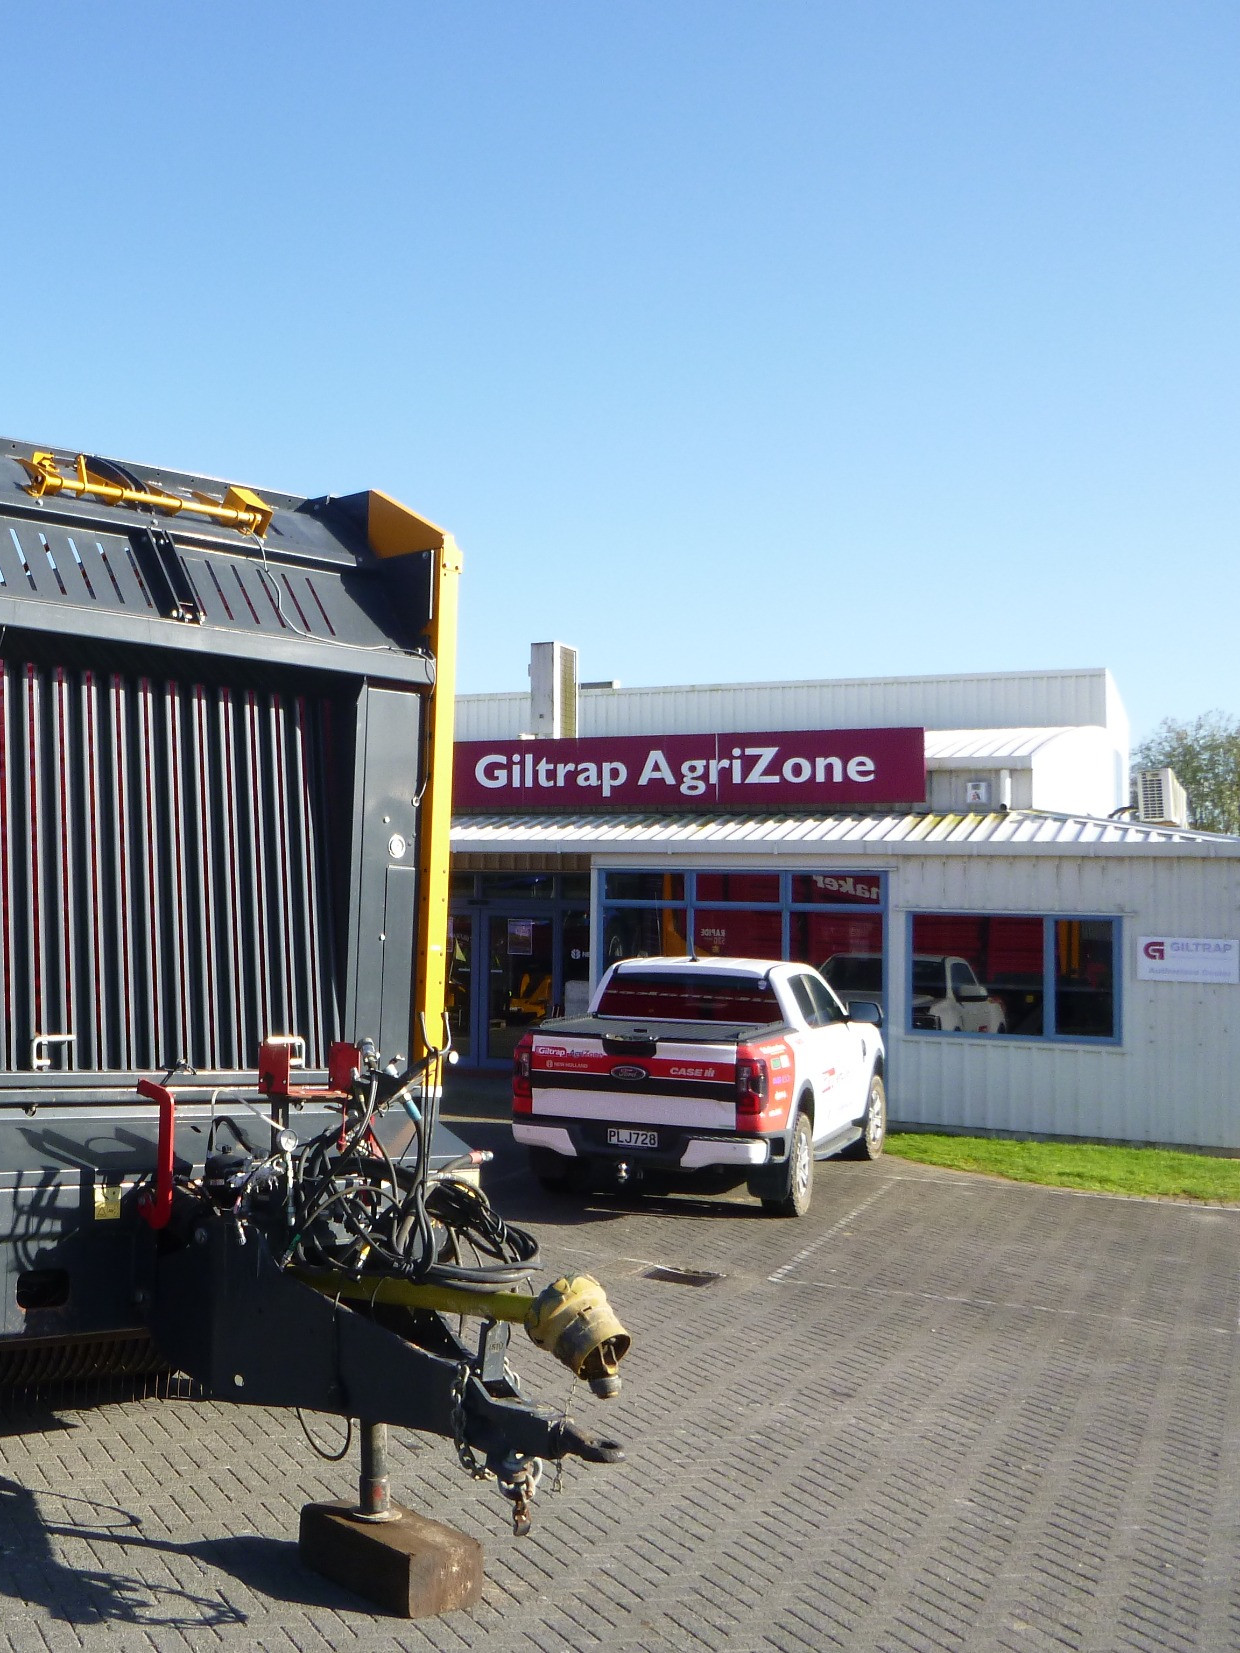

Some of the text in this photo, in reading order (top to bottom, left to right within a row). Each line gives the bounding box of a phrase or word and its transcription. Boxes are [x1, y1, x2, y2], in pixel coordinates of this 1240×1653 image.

[474, 747, 876, 797] Giltrap AgriZone
[1170, 941, 1232, 954] GILTRAP
[538, 1047, 566, 1057] Giltrap
[670, 1067, 703, 1077] CASE
[609, 1129, 657, 1146] PLJ728
